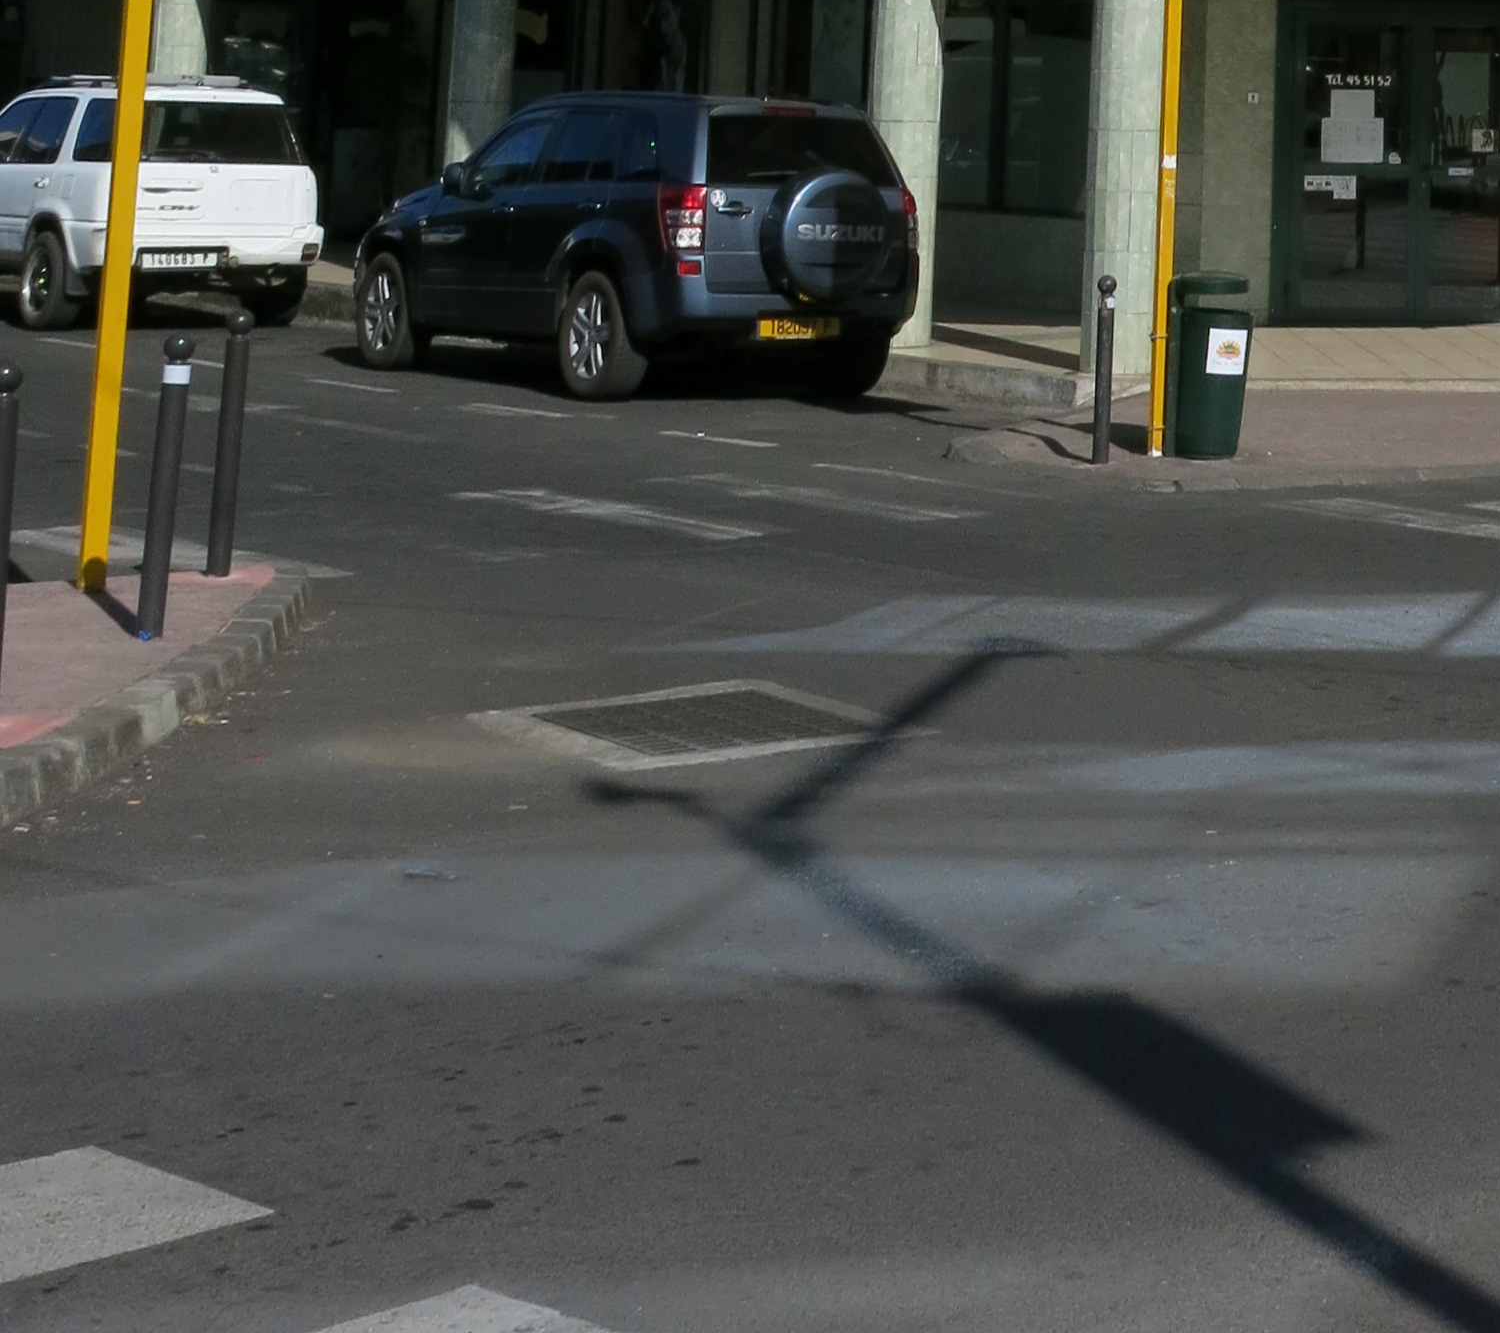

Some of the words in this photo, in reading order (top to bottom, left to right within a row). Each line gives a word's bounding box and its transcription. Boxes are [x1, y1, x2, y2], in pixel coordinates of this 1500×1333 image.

[1346, 74, 1361, 85] 45
[1363, 75, 1375, 86] 51
[1377, 75, 1392, 86] 52
[797, 223, 885, 242] SUZUKI
